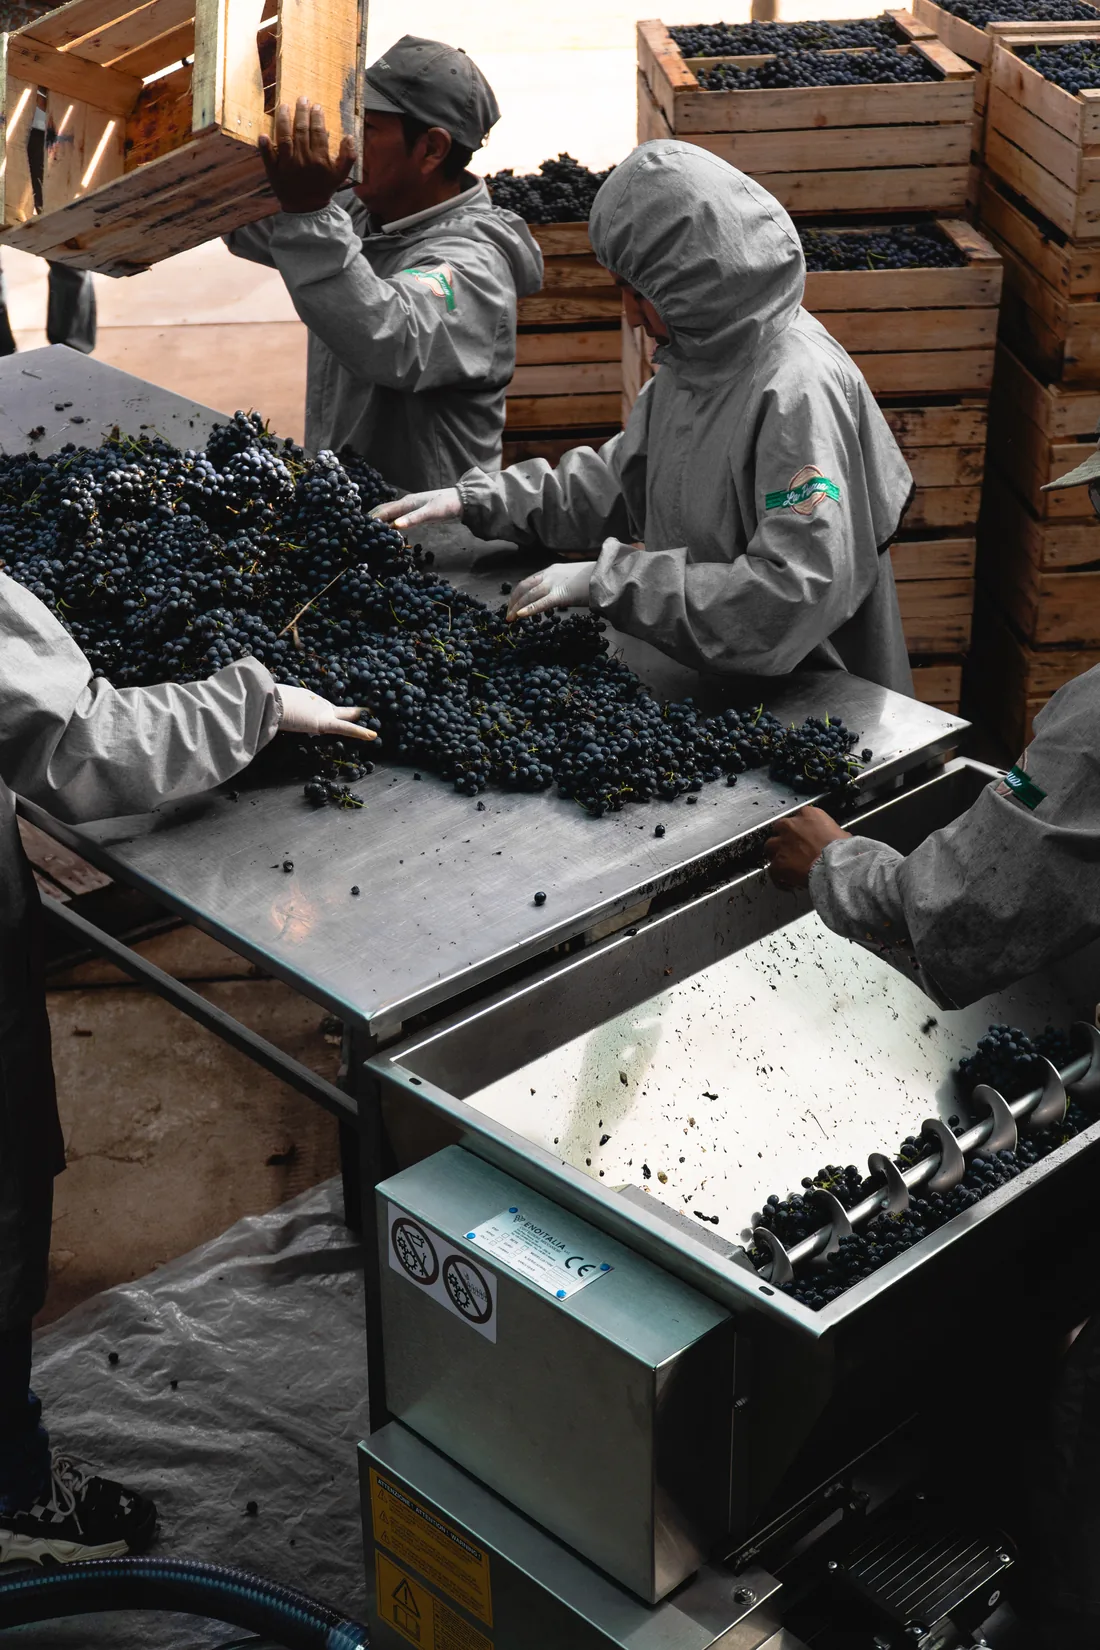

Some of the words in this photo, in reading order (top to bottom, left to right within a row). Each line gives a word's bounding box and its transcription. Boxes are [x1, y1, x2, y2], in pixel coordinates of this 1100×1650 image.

[523, 1221, 566, 1250] ENOITALIA
[564, 1255, 597, 1277] CE
[377, 1478, 411, 1507] ATTENZIONE
[415, 1507, 446, 1533] ATTENTION
[450, 1532, 478, 1557] WARNING
